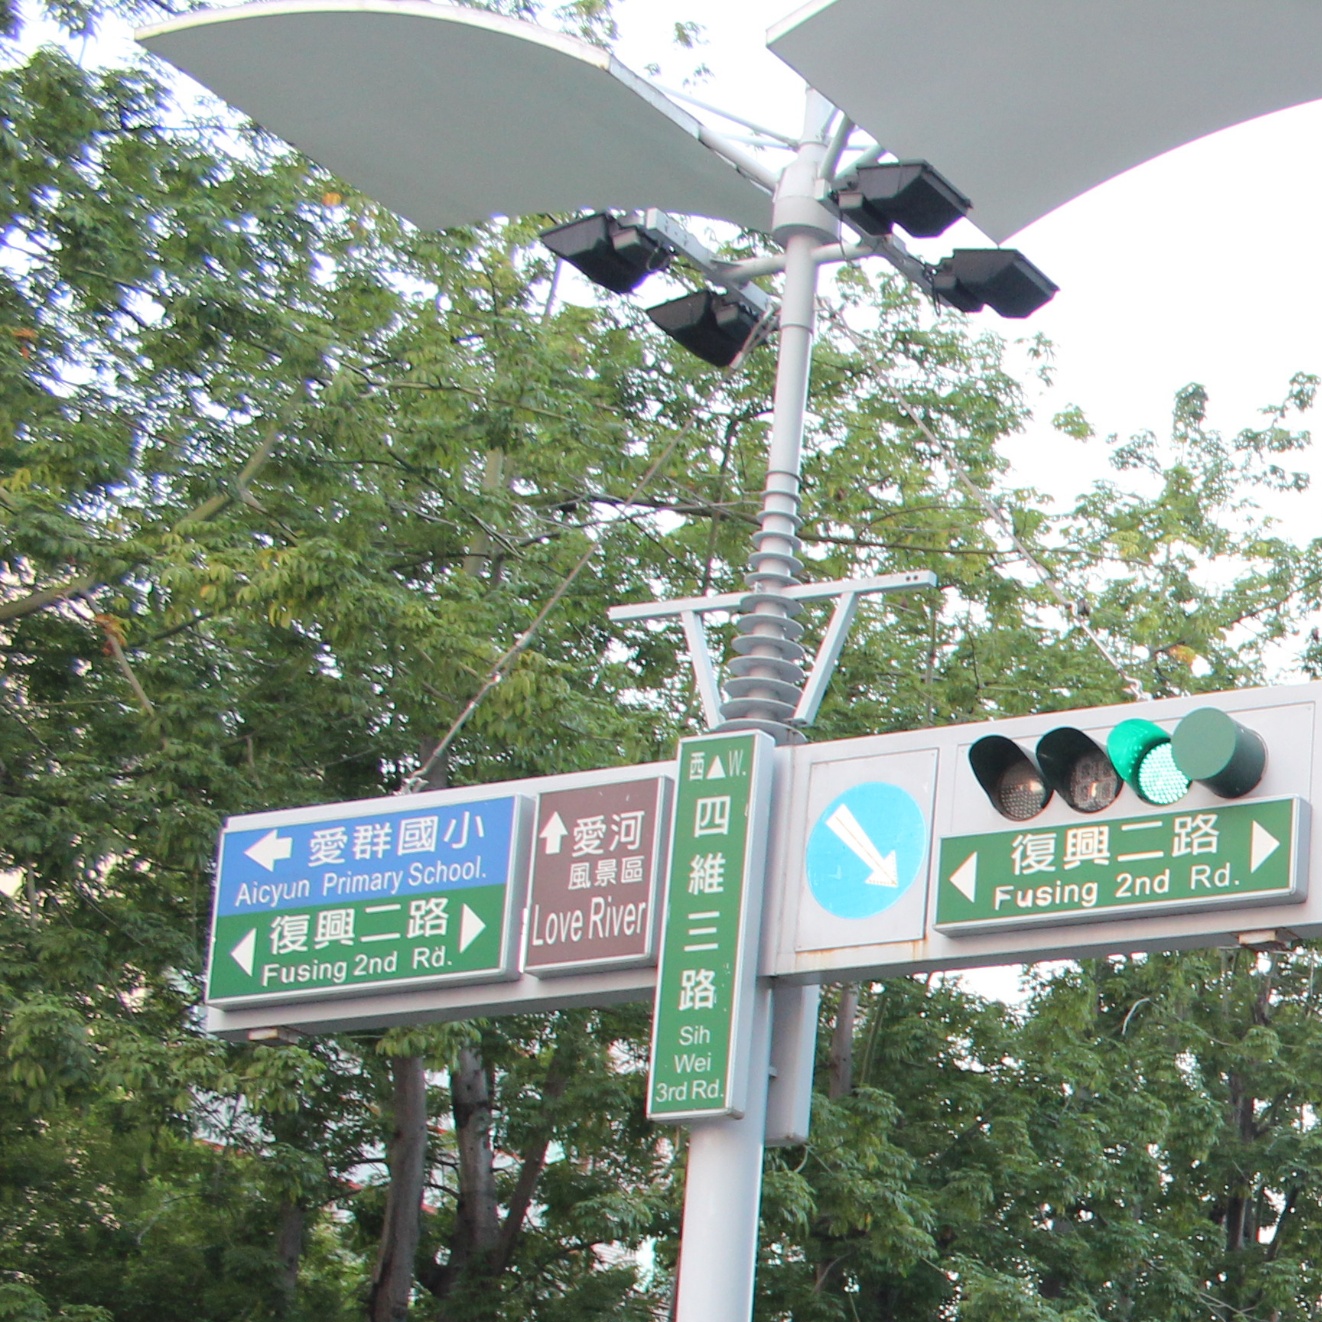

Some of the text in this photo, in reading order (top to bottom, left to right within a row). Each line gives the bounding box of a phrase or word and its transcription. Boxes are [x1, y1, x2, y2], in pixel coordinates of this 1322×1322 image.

[689, 751, 706, 781] 西
[728, 749, 747, 777] W.
[307, 810, 486, 868] 愛群國小
[571, 810, 646, 858] 愛河
[1009, 813, 1220, 877] 復興二路
[234, 855, 487, 908] Aicyun Primary School.
[567, 855, 646, 890] 風景區
[993, 862, 1241, 912] Fusing 2nd Rd.
[269, 897, 450, 956] 復興二路
[532, 894, 647, 947] Love River
[677, 795, 732, 1011] 四維三路
[261, 944, 454, 988] Fusing 2nd Rd.
[678, 1025, 711, 1047] Sih
[673, 1051, 713, 1074] Wei
[655, 1078, 725, 1103] 3rd Rd.
